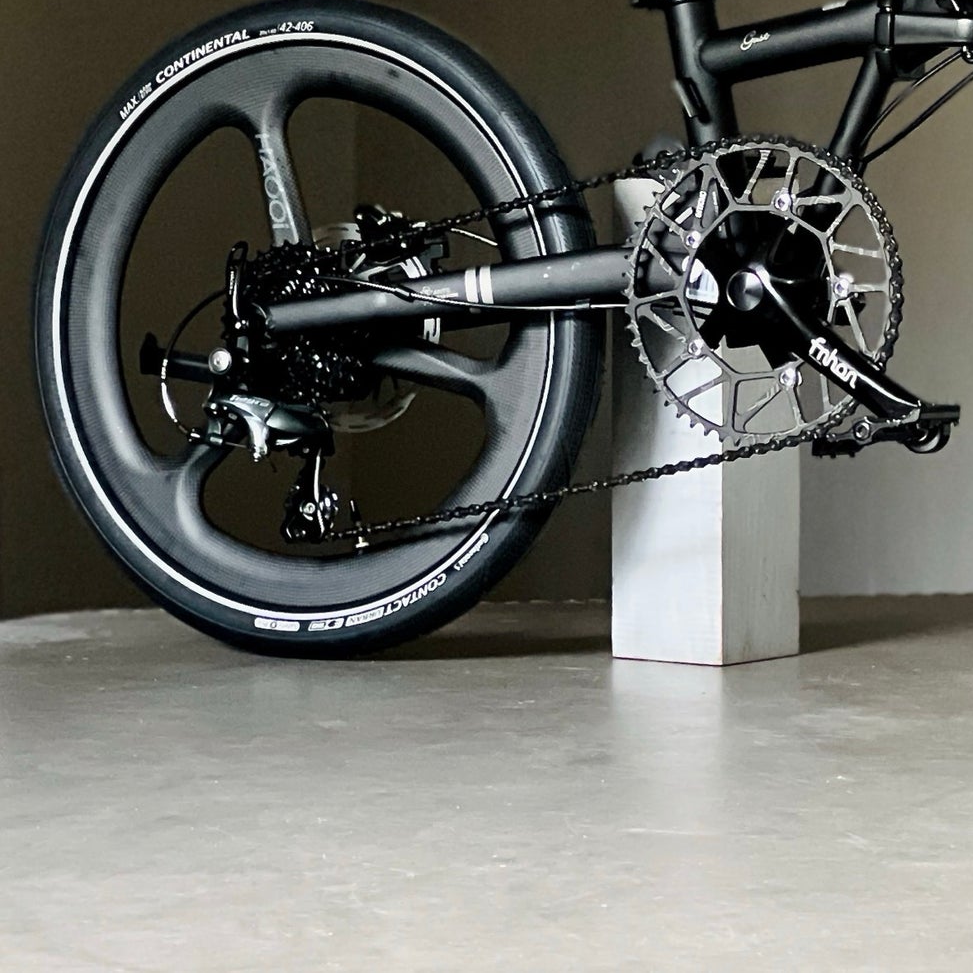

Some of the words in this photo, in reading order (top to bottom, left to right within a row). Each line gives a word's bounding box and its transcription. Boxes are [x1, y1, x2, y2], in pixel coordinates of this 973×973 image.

[155, 29, 251, 84] CONTINENTAL
[808, 337, 859, 389] fnhon
[383, 573, 448, 617] CONTACT
